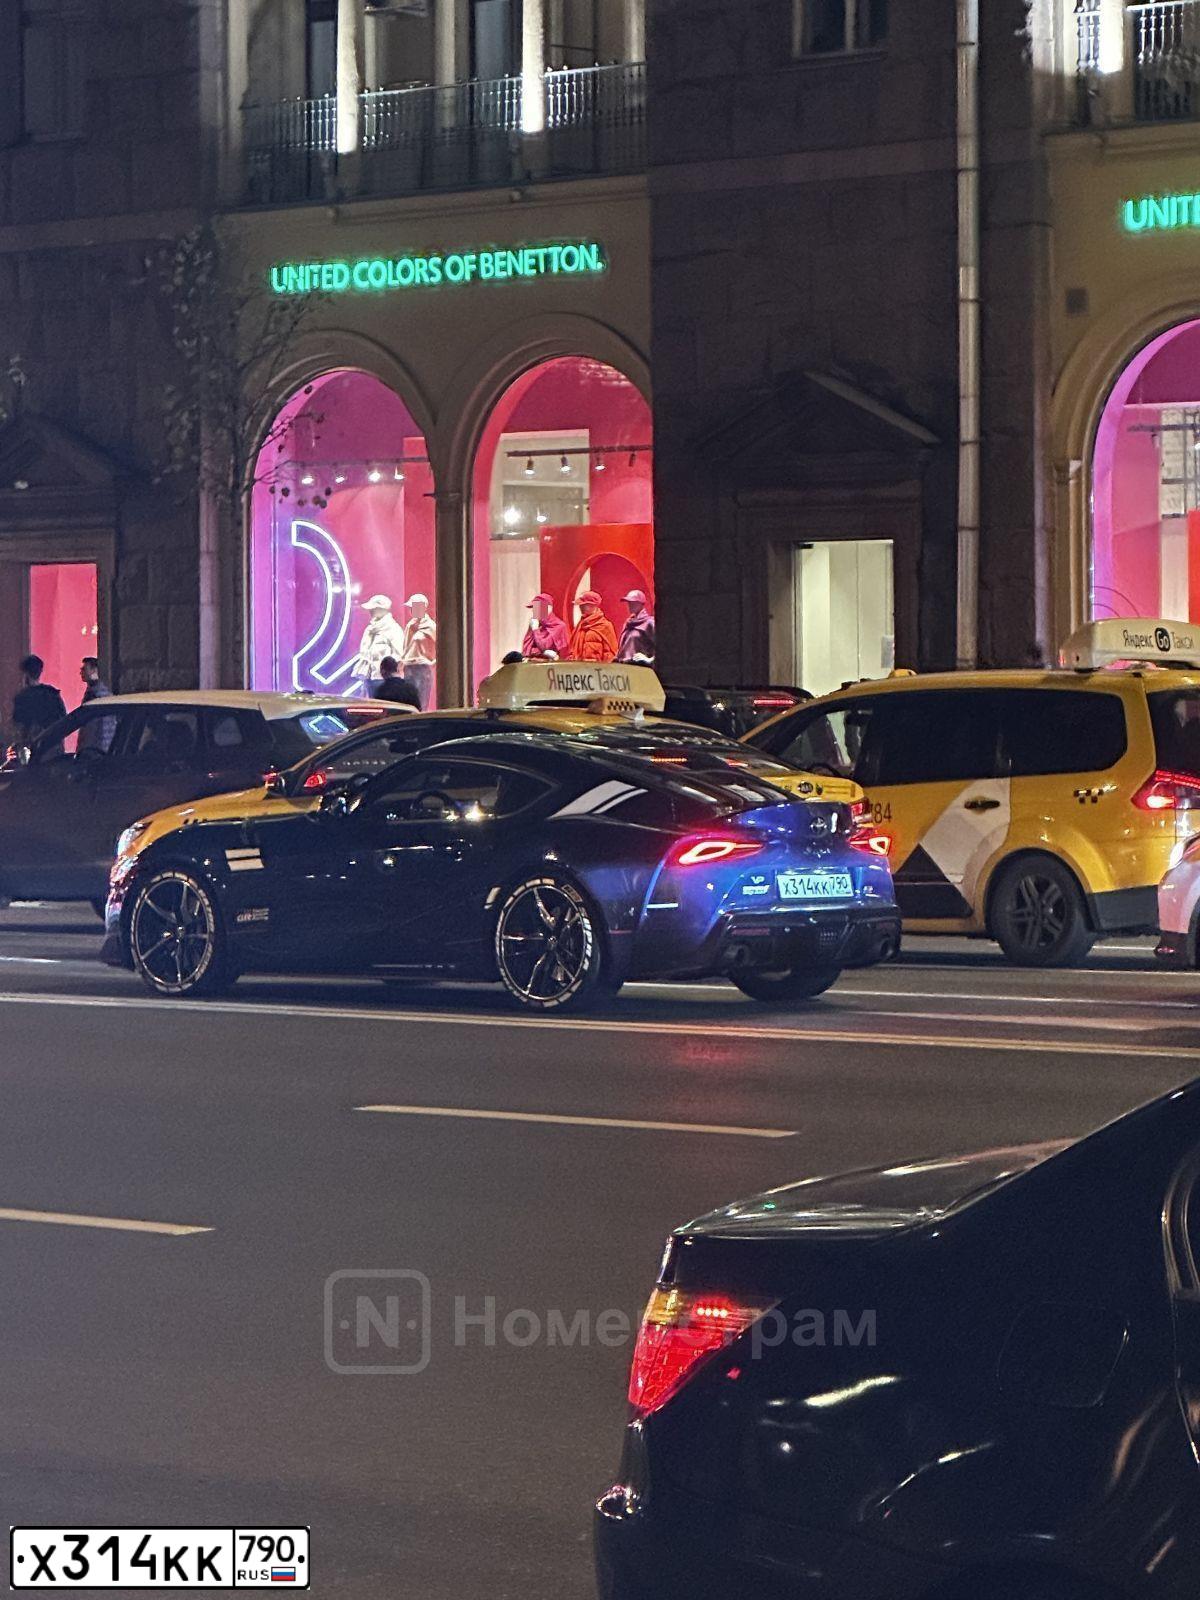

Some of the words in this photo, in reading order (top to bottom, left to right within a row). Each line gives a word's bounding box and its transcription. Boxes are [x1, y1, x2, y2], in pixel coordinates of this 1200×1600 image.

[271, 263, 350, 293] UNITED
[353, 257, 442, 289] COLORS
[444, 254, 477, 282] OF
[480, 243, 603, 280] BENETTON.
[1122, 629, 1154, 649] Яндекс
[1155, 630, 1170, 650] Go
[547, 667, 595, 693] Яндекс
[594, 668, 631, 692] Такси
[830, 876, 848, 890] 790
